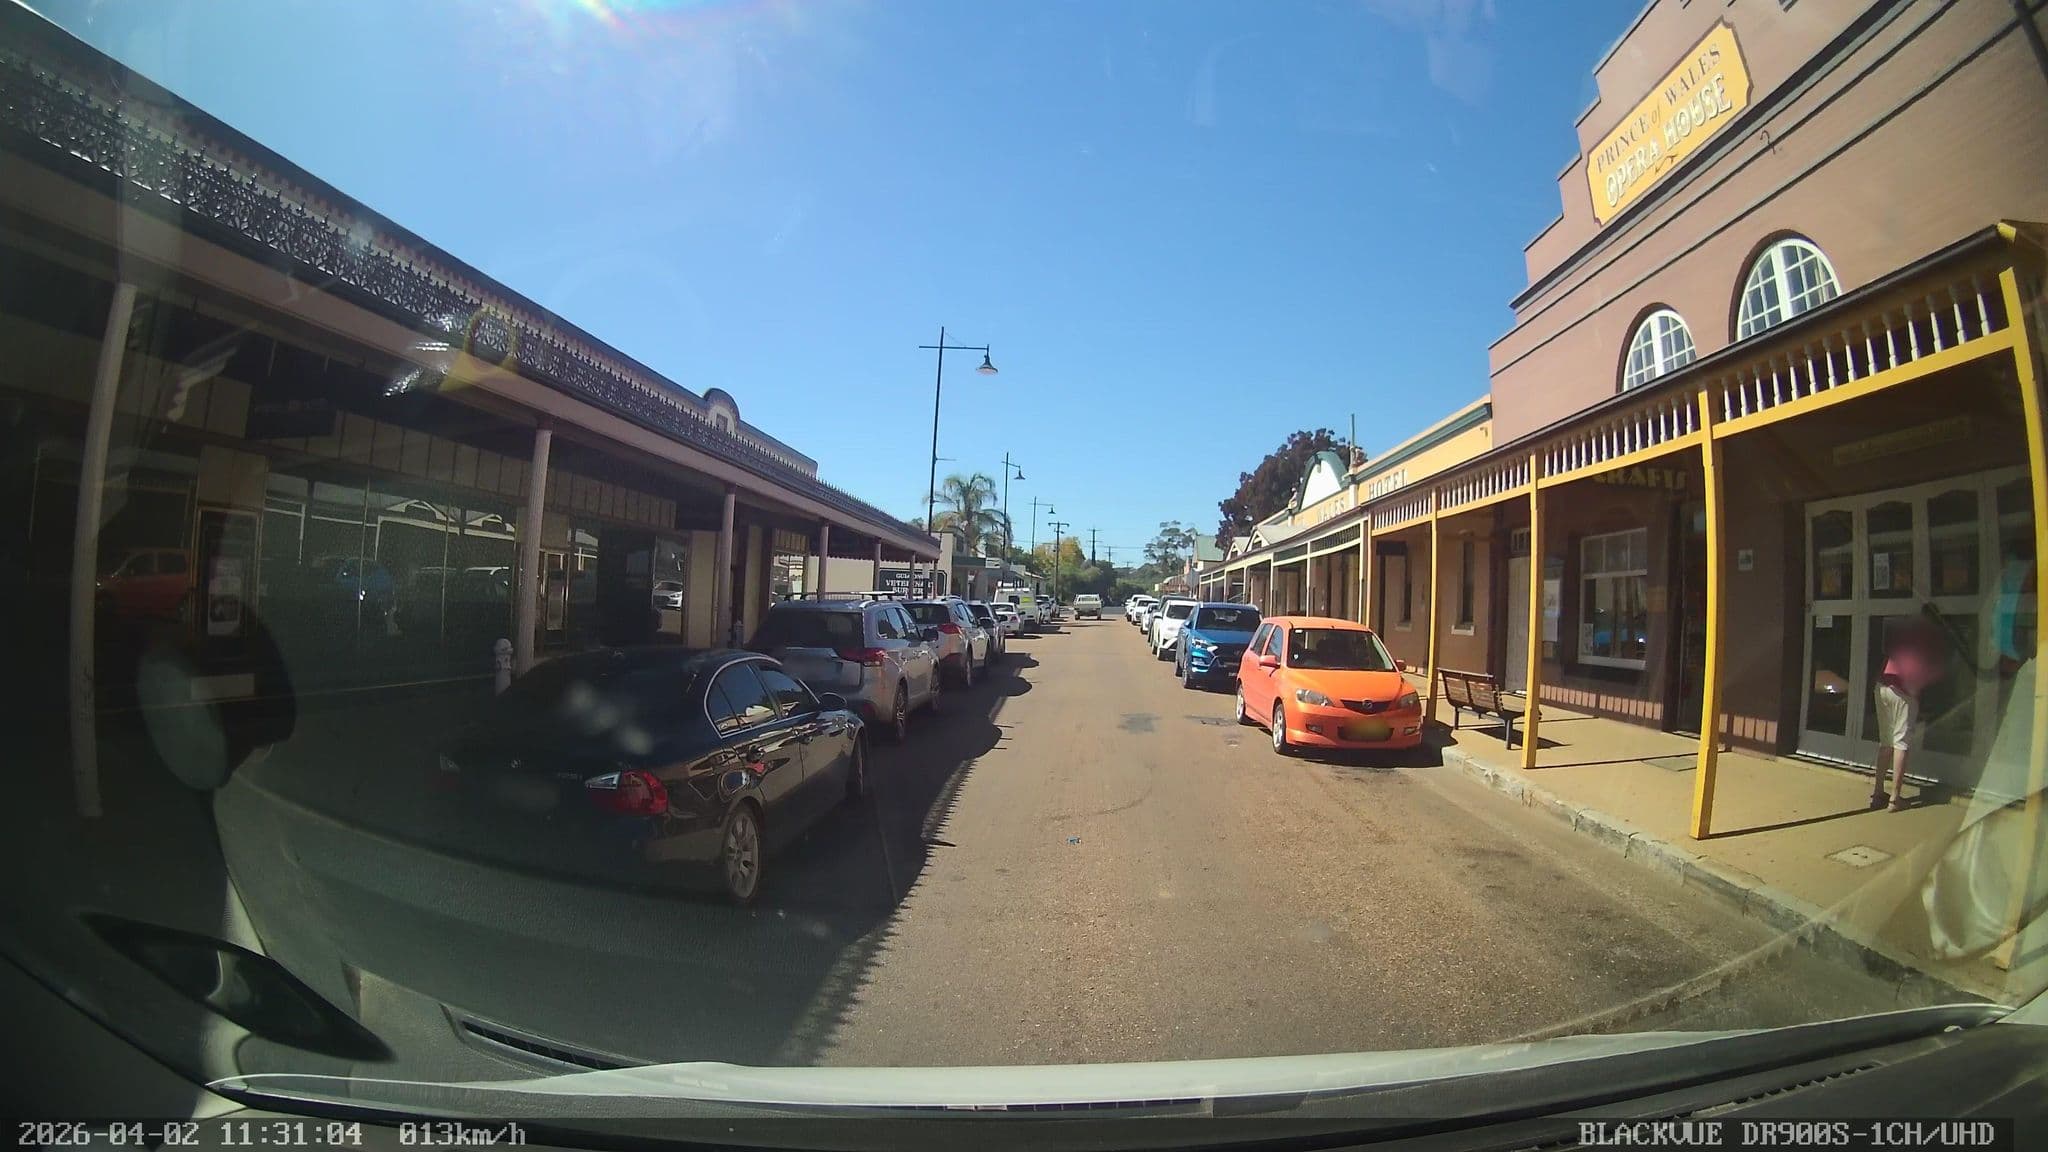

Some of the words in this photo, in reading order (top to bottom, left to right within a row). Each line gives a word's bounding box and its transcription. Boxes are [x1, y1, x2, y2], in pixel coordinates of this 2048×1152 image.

[1597, 113, 1650, 173] PRINCE
[1651, 101, 1661, 128] of
[1664, 43, 1721, 106] WALES
[1605, 135, 1660, 207] OPERA
[1662, 73, 1732, 150] HOUSE
[1368, 469, 1408, 500] HOTEL
